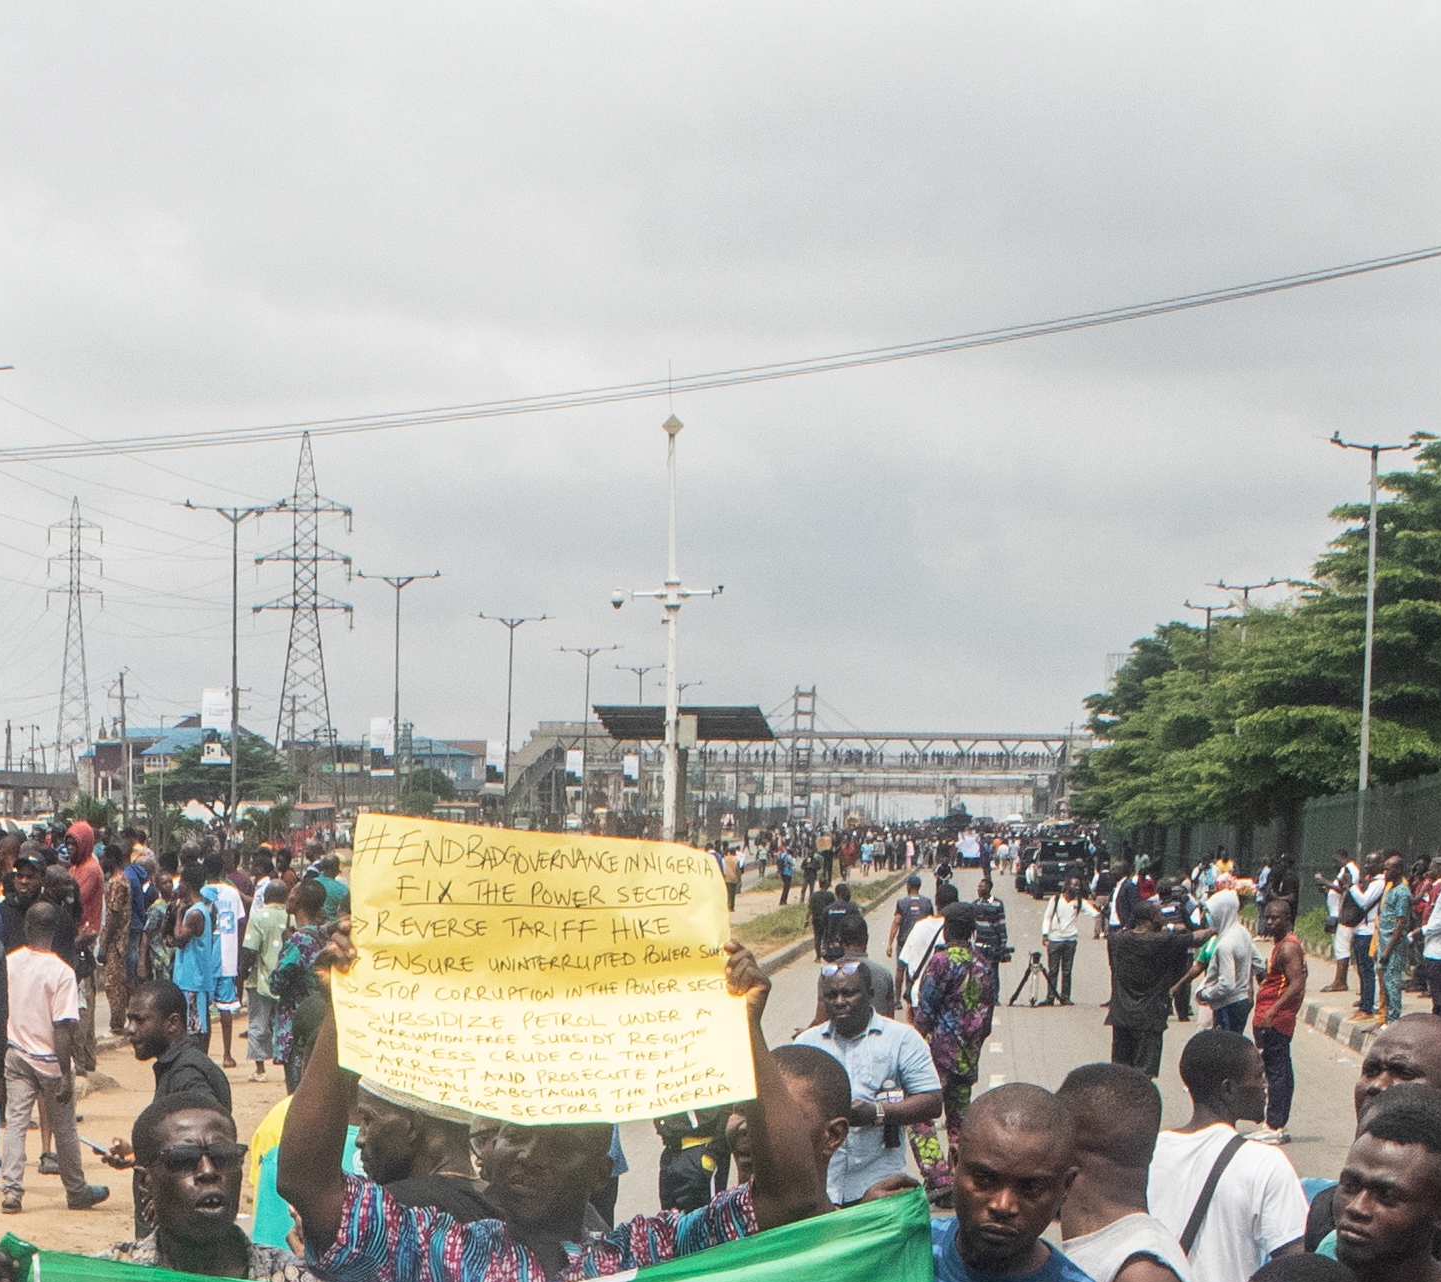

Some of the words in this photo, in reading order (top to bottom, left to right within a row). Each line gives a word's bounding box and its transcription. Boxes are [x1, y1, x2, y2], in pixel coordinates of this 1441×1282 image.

[397, 875, 453, 904] FIX
[468, 879, 516, 905] THE
[531, 881, 605, 907] POWER
[617, 882, 692, 905] SECTOR
[376, 910, 488, 938] REVERSE
[504, 916, 598, 942] TARIFF
[612, 917, 671, 943] HIKE
[372, 950, 474, 975] ENSURE
[489, 951, 636, 972] UNINTERRUPTED
[643, 944, 691, 965] POWER
[363, 981, 420, 1001] STOP
[435, 984, 555, 1002] CORRUPTION
[565, 986, 583, 998] IN
[587, 981, 618, 996] THE
[625, 977, 682, 995] POWER
[360, 1005, 504, 1030] SUBSIDIZE
[523, 1011, 606, 1029] PETROL
[619, 1010, 682, 1026] UNDER
[368, 1021, 518, 1045] CORRUPTION-FREE
[532, 1032, 615, 1046] SUBSIDY
[629, 1027, 708, 1046] REGIME
[376, 1039, 476, 1062] ADDRESS
[489, 1050, 559, 1063] CRUDE
[569, 1051, 608, 1062] OIL
[619, 1041, 696, 1061] THEFT
[377, 1053, 476, 1080] ARREST
[481, 1071, 525, 1084] AND
[536, 1069, 647, 1085] PROSECUTE
[656, 1060, 698, 1079] ALL
[387, 1078, 425, 1095] OIL
[460, 1096, 498, 1111] GAS
[511, 1104, 602, 1118] SECTORS
[615, 1104, 645, 1115] OF
[483, 1086, 598, 1100] SABOTAGING
[610, 1088, 647, 1099] THE
